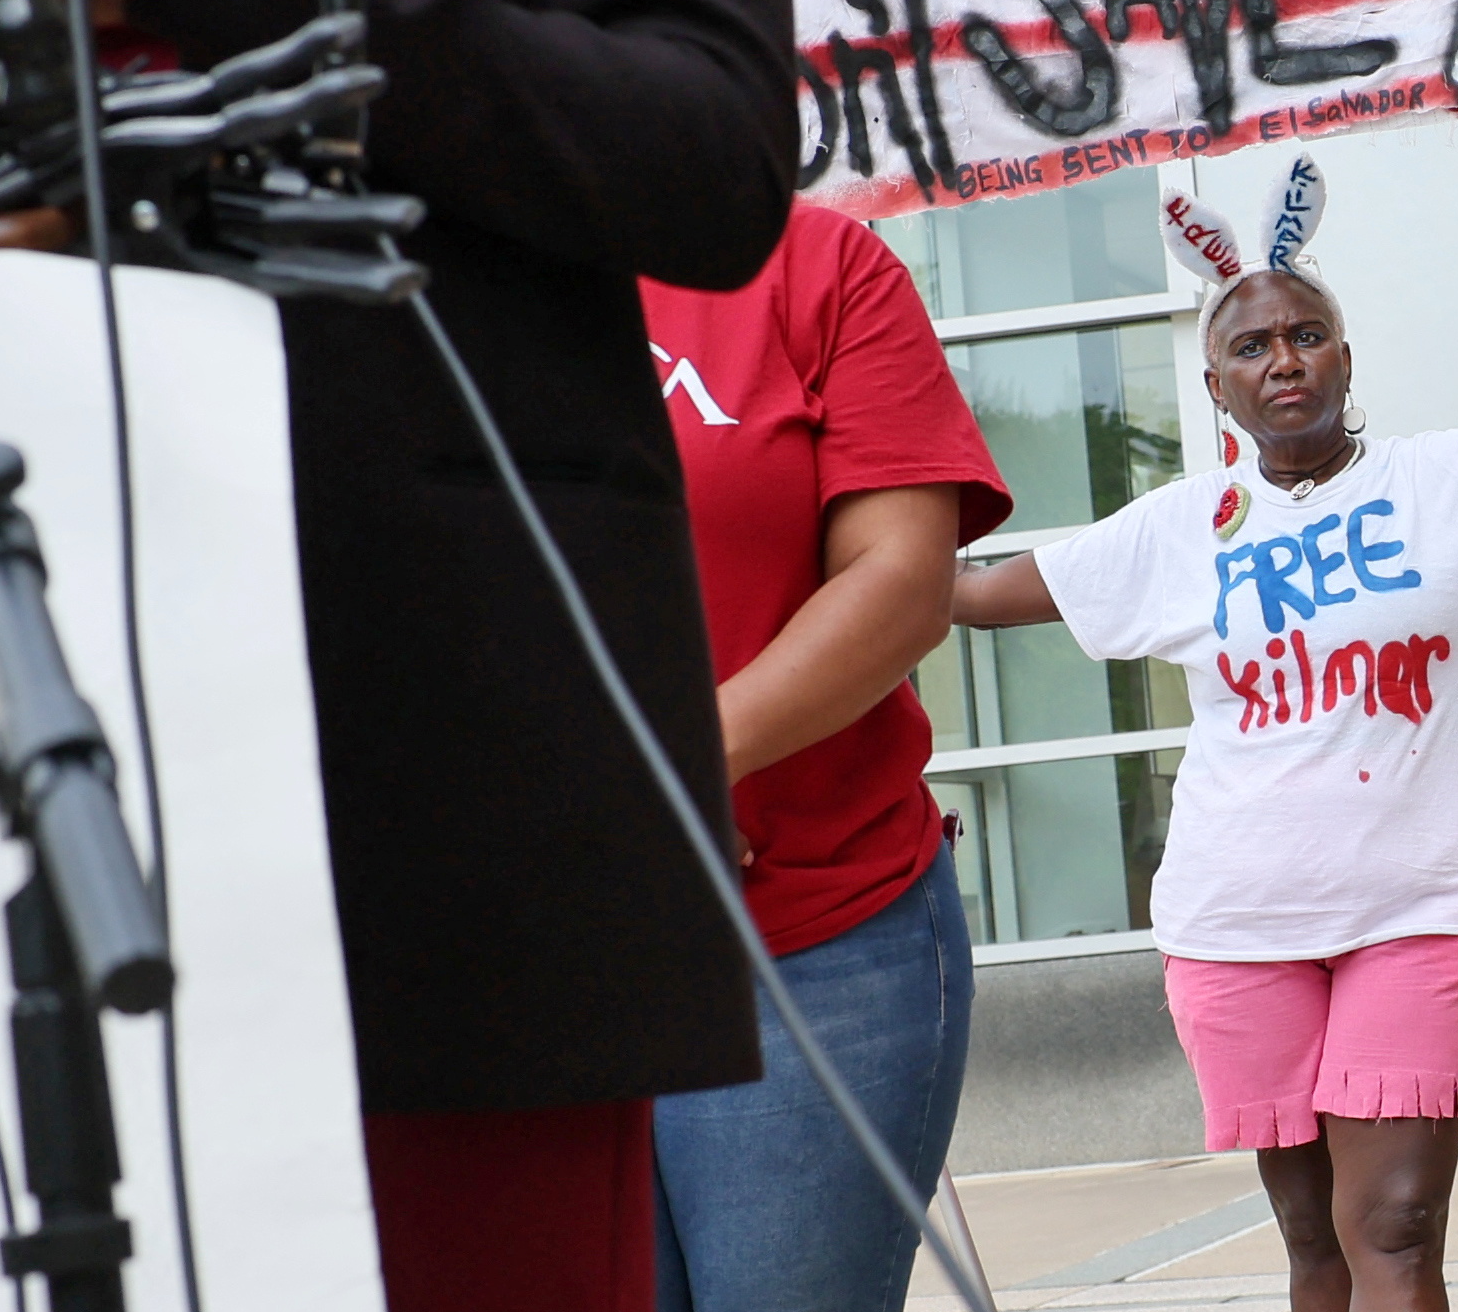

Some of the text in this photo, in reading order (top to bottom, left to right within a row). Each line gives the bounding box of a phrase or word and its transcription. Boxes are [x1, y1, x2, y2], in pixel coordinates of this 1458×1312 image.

[955, 154, 1043, 199] BEING
[1062, 128, 1150, 182] SENT
[1163, 125, 1211, 156] TO
[1166, 196, 1242, 278] FREE
[1213, 499, 1422, 640] FREE
